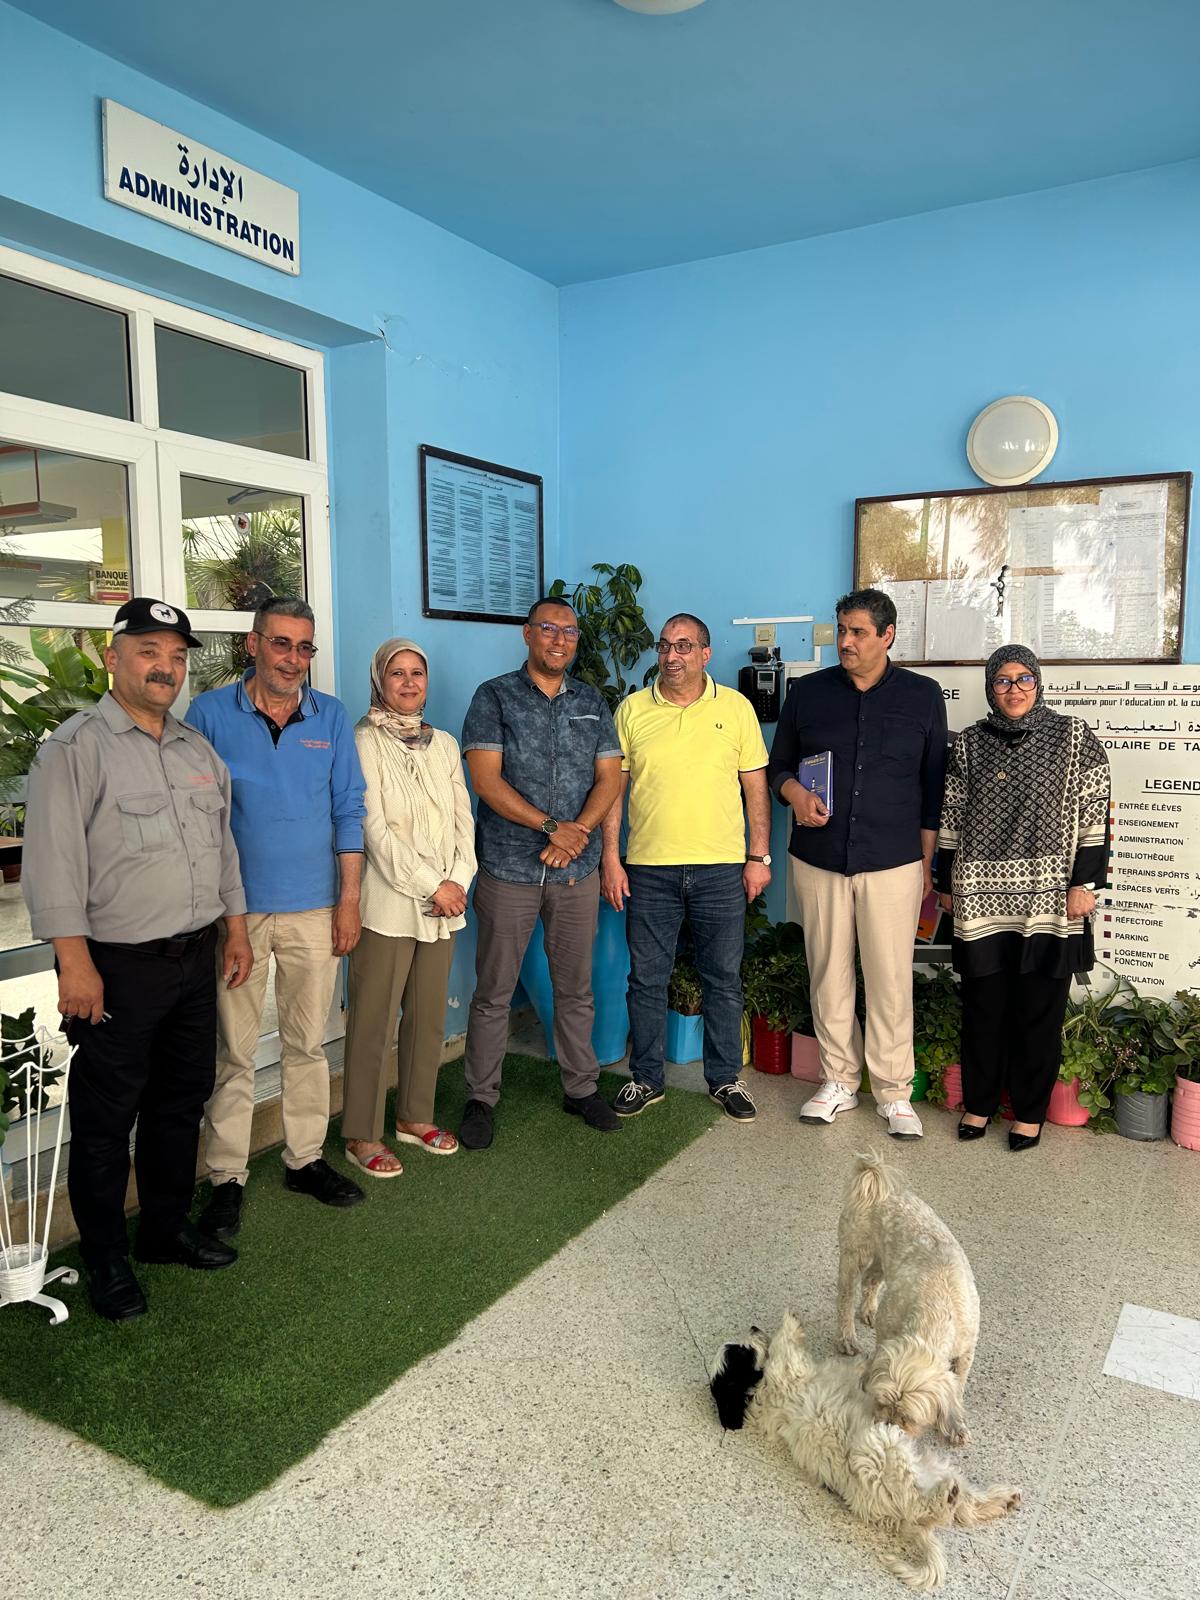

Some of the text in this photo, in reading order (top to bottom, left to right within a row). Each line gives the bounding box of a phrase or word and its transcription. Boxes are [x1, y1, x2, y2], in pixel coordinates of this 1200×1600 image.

[177, 142, 243, 204] الإدارة
[118, 166, 295, 262] ADMINISTRATION
[95, 570, 129, 580] BANQUE
[1099, 699, 1118, 707] pour
[1158, 741, 1176, 751] DE
[1118, 802, 1150, 811] ENTRÉE
[1118, 818, 1179, 829] ENSEIGNEMENT
[1118, 835, 1184, 846] ADMINISTRATION
[1117, 851, 1175, 862] BIBLIOTHÈQUE
[1117, 867, 1156, 877] TERRAINS
[1157, 871, 1190, 880] SPORTS
[1116, 884, 1152, 893] ESPACES
[1155, 887, 1180, 896] VERTS
[1115, 900, 1154, 910] INTERNAT
[1115, 916, 1164, 927] RÉFECTOIRE
[1115, 932, 1149, 942] PARKING
[1114, 949, 1157, 959] LOGEMENT
[1114, 957, 1154, 968] FONCTION
